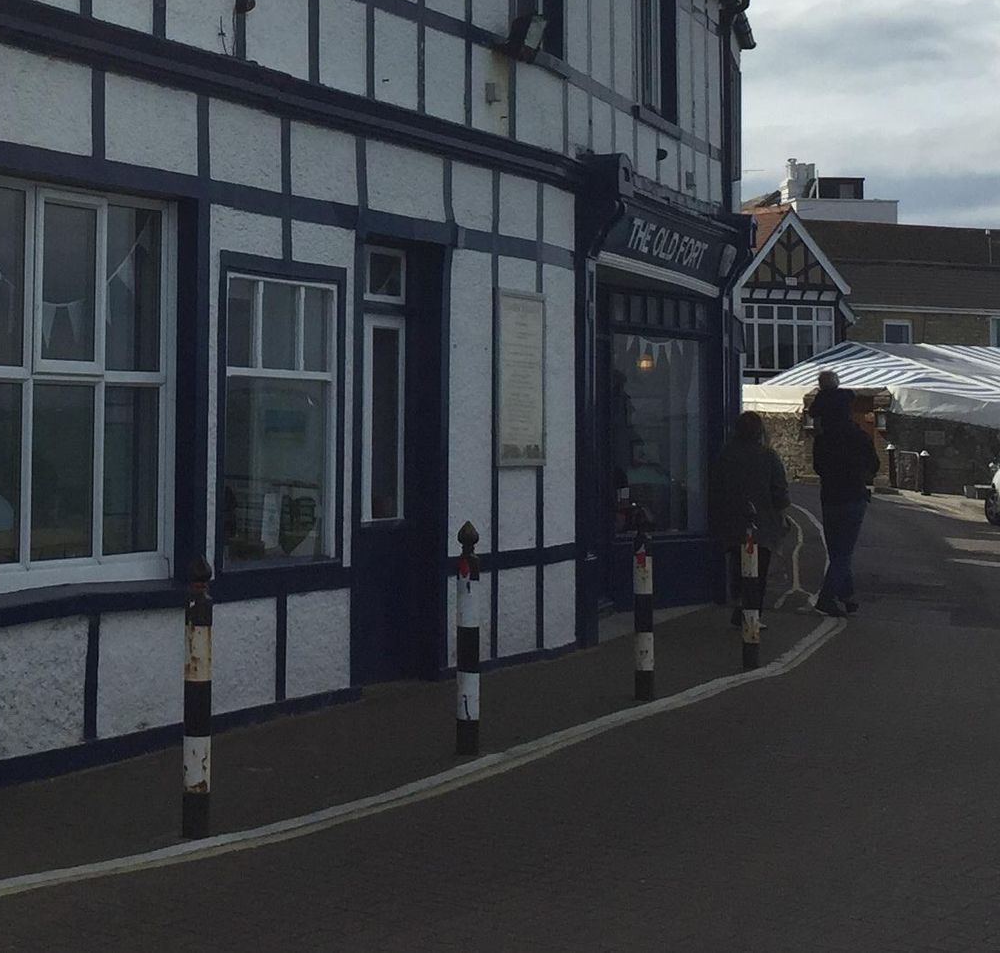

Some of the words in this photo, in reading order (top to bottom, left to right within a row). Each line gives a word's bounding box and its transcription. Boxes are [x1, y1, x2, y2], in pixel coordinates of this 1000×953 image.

[628, 217, 656, 253] THE
[653, 227, 679, 260] OLD
[675, 236, 708, 269] FORT
